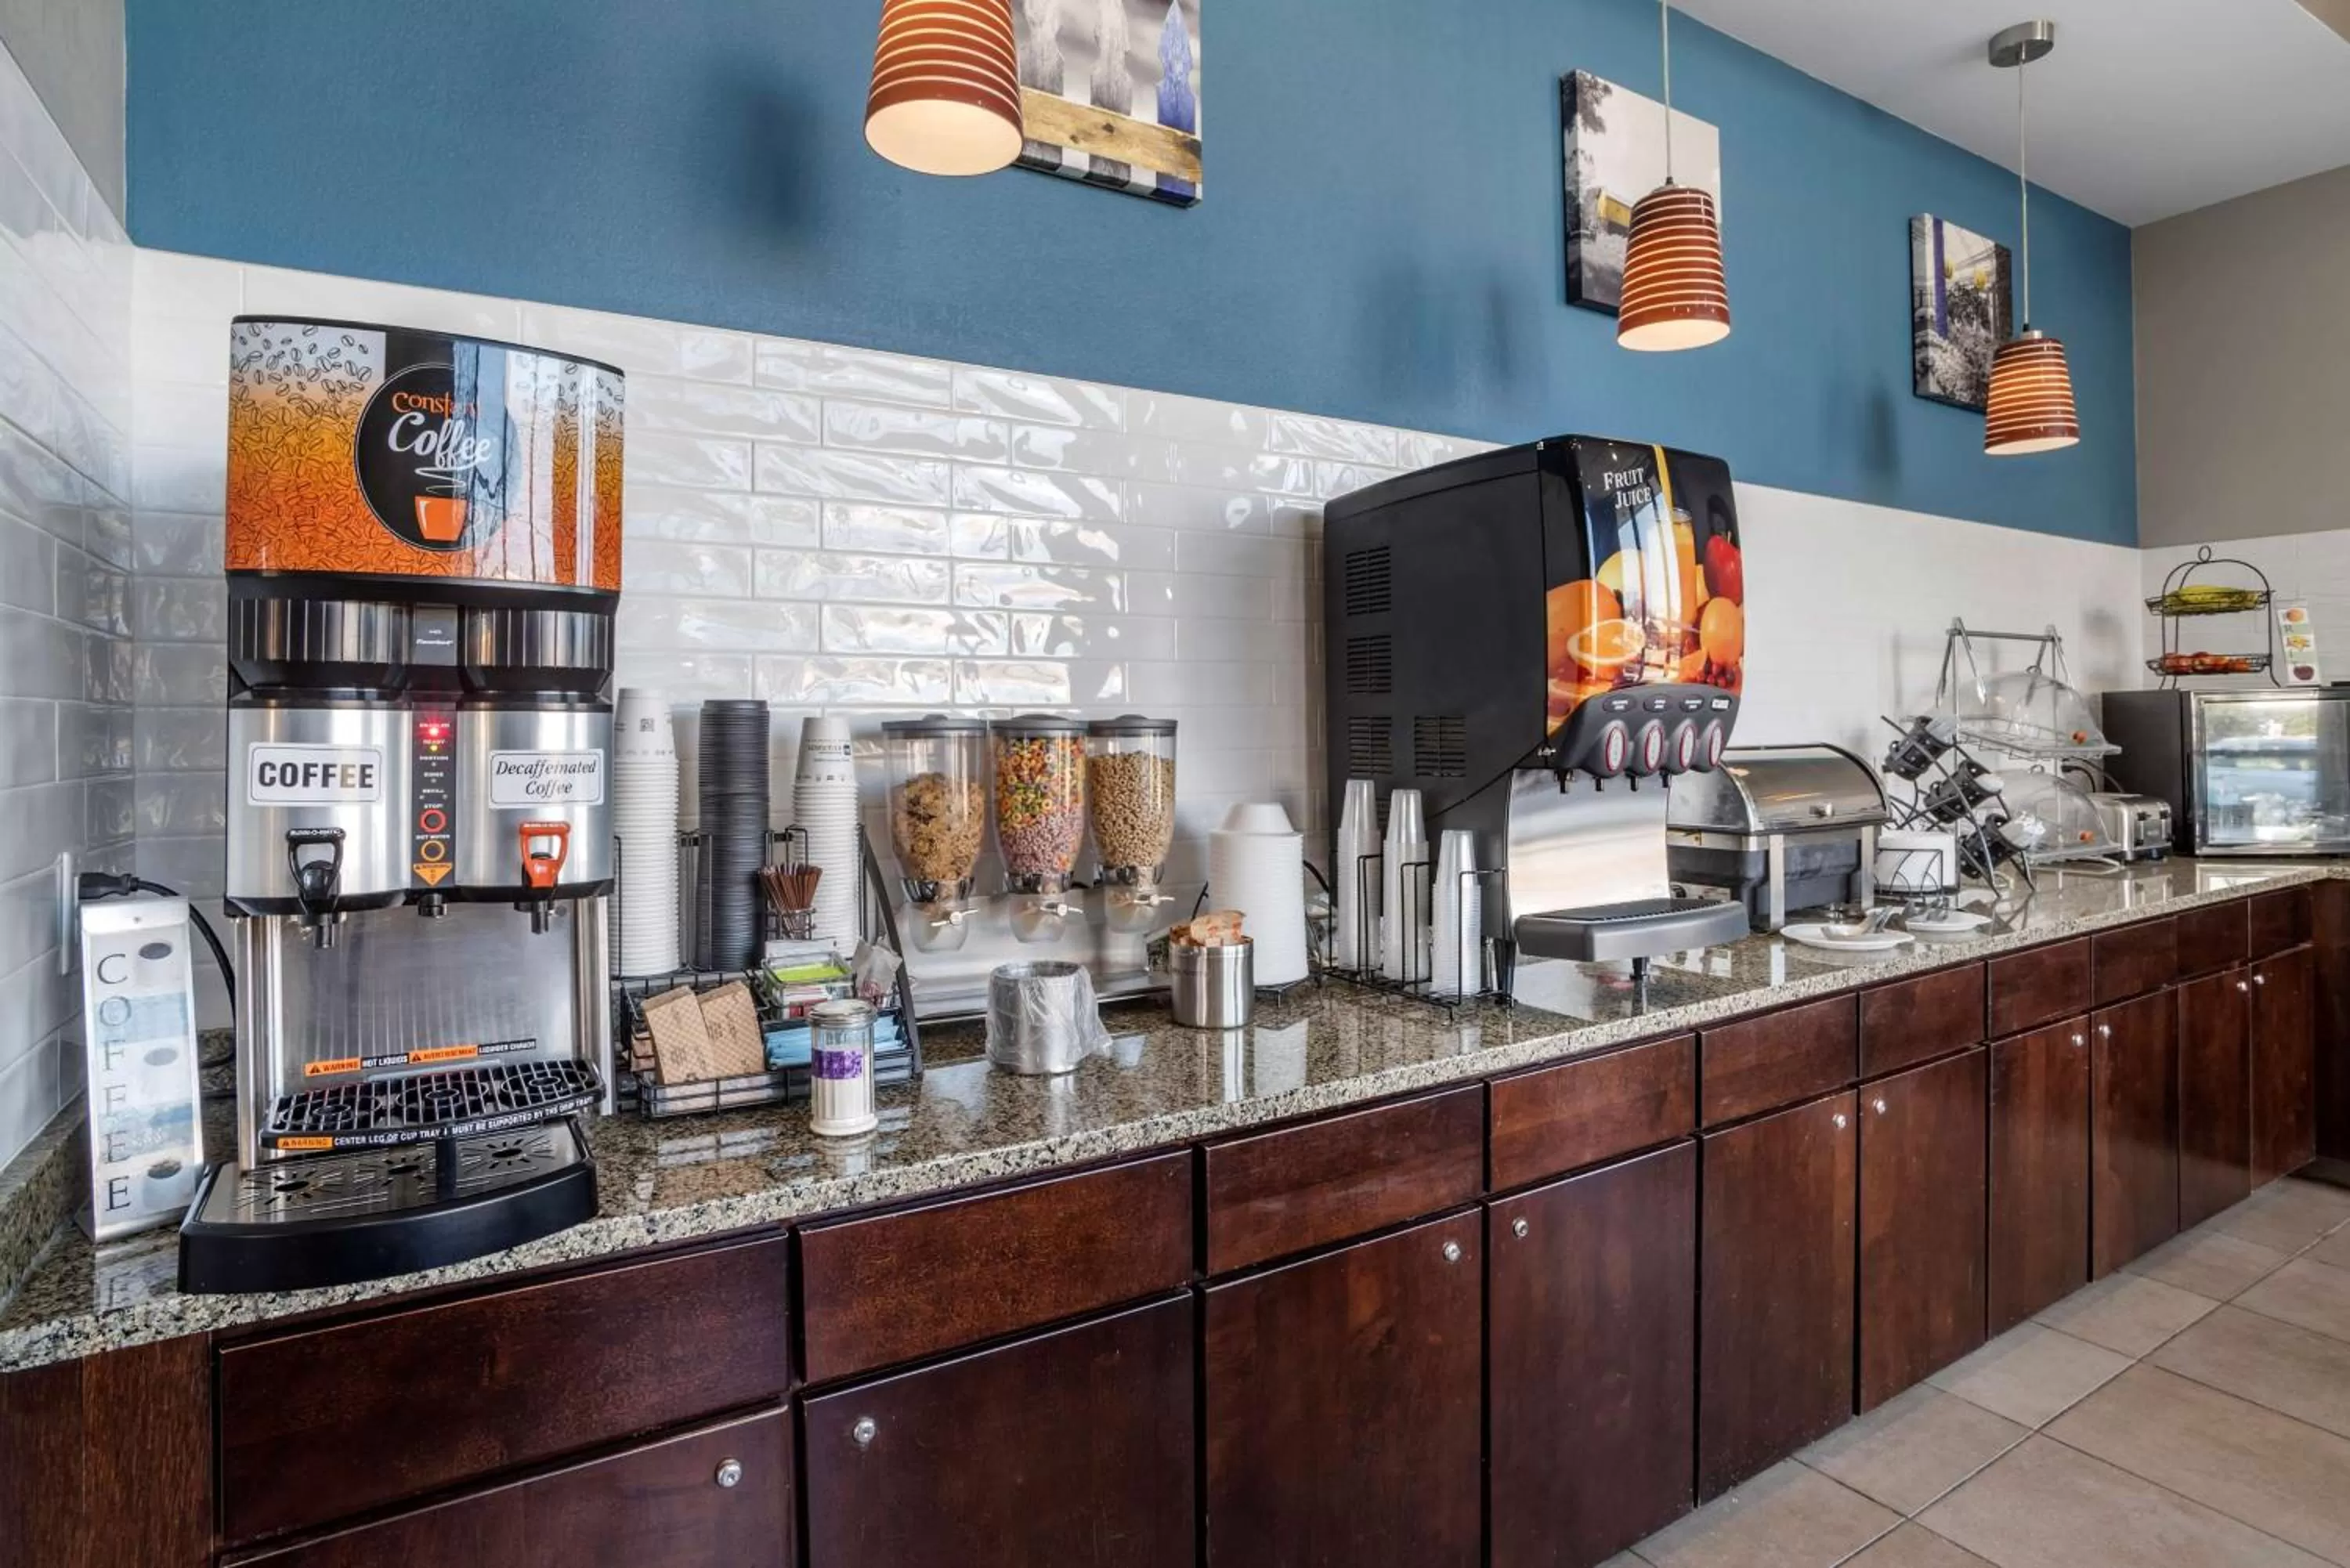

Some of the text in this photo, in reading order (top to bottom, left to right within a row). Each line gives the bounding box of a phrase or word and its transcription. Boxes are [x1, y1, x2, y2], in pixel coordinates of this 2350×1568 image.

[392, 391, 480, 420] Const
[388, 411, 493, 470] Coffee
[1603, 468, 1644, 491] FRUIT
[1614, 486, 1652, 510] JUICE
[258, 761, 374, 788] COFFEE
[496, 759, 597, 779] Decaffeinated
[526, 779, 573, 798] Coffee
[322, 1060, 359, 1072] WARNING
[362, 1057, 378, 1068] HOT
[96, 952, 132, 1212] COFFEE
[334, 1136, 367, 1147] CENTER
[368, 1134, 384, 1143] LEG
[386, 1133, 398, 1143] OF
[400, 1132, 418, 1141] CUP
[420, 1128, 440, 1138] TRAY
[452, 1123, 473, 1134] MUST
[475, 1120, 486, 1130] BE
[488, 1113, 533, 1129] SUPPORTED
[534, 1111, 543, 1120] BY
